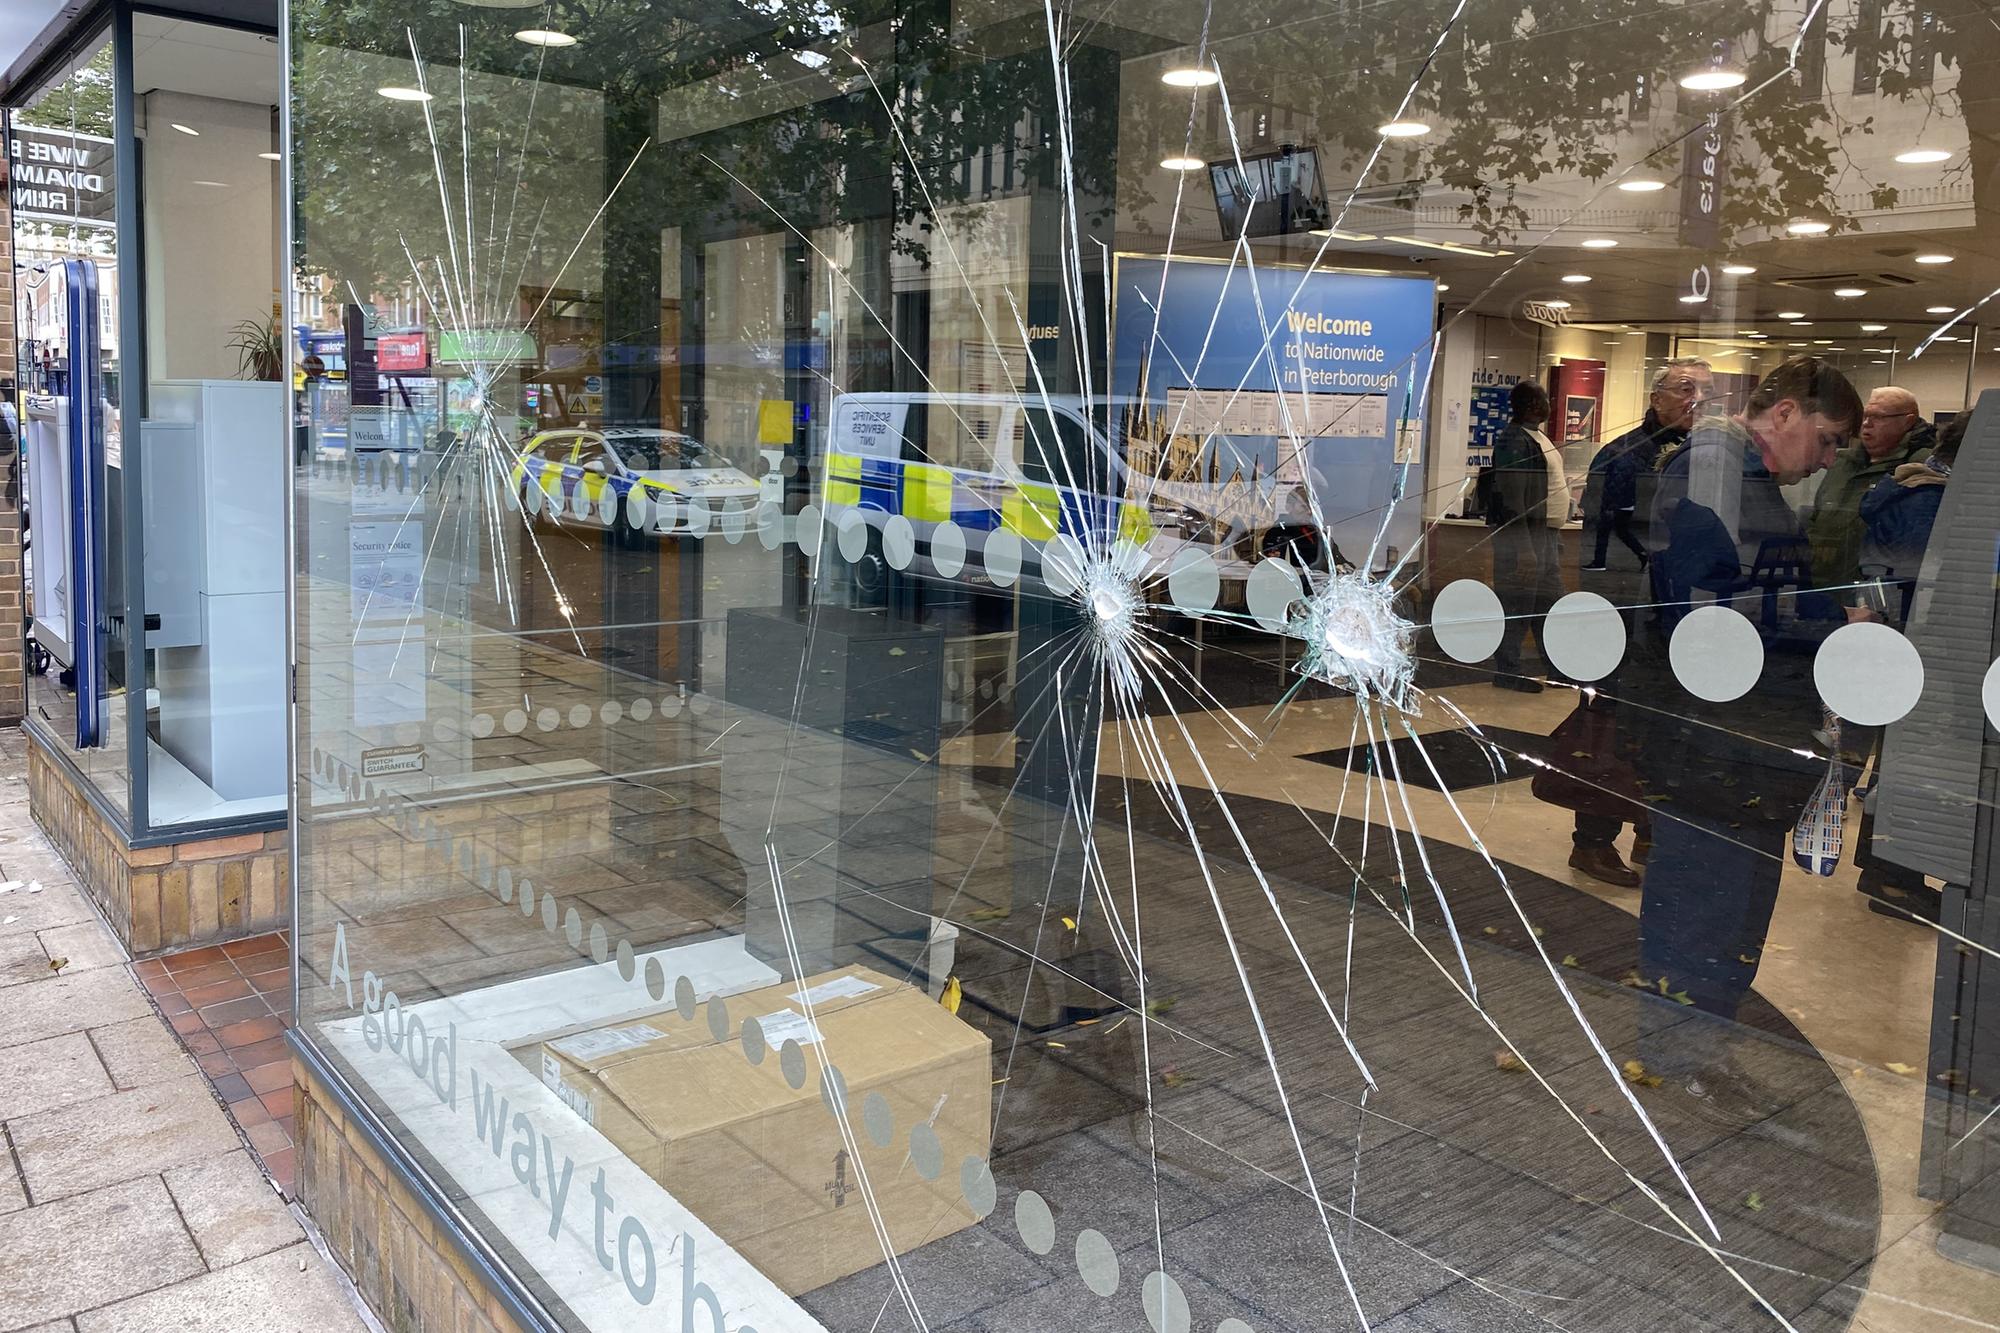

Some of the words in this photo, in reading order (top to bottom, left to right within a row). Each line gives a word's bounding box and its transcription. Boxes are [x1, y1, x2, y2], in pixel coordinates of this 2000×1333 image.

[1287, 311, 1373, 337] Welcome
[1284, 341, 1300, 358] to
[1303, 341, 1385, 362] Nationwide
[1284, 366, 1297, 384] in
[1302, 367, 1398, 391] Peterborough
[1472, 367, 1493, 384] ride
[353, 541, 388, 551] Security
[389, 541, 411, 550] notice
[367, 758, 394, 767] SWITCH
[367, 761, 416, 773] GUARANTEE
[330, 921, 354, 1010] A
[362, 970, 457, 1113] good
[470, 1067, 574, 1243] way
[590, 1166, 657, 1306] to
